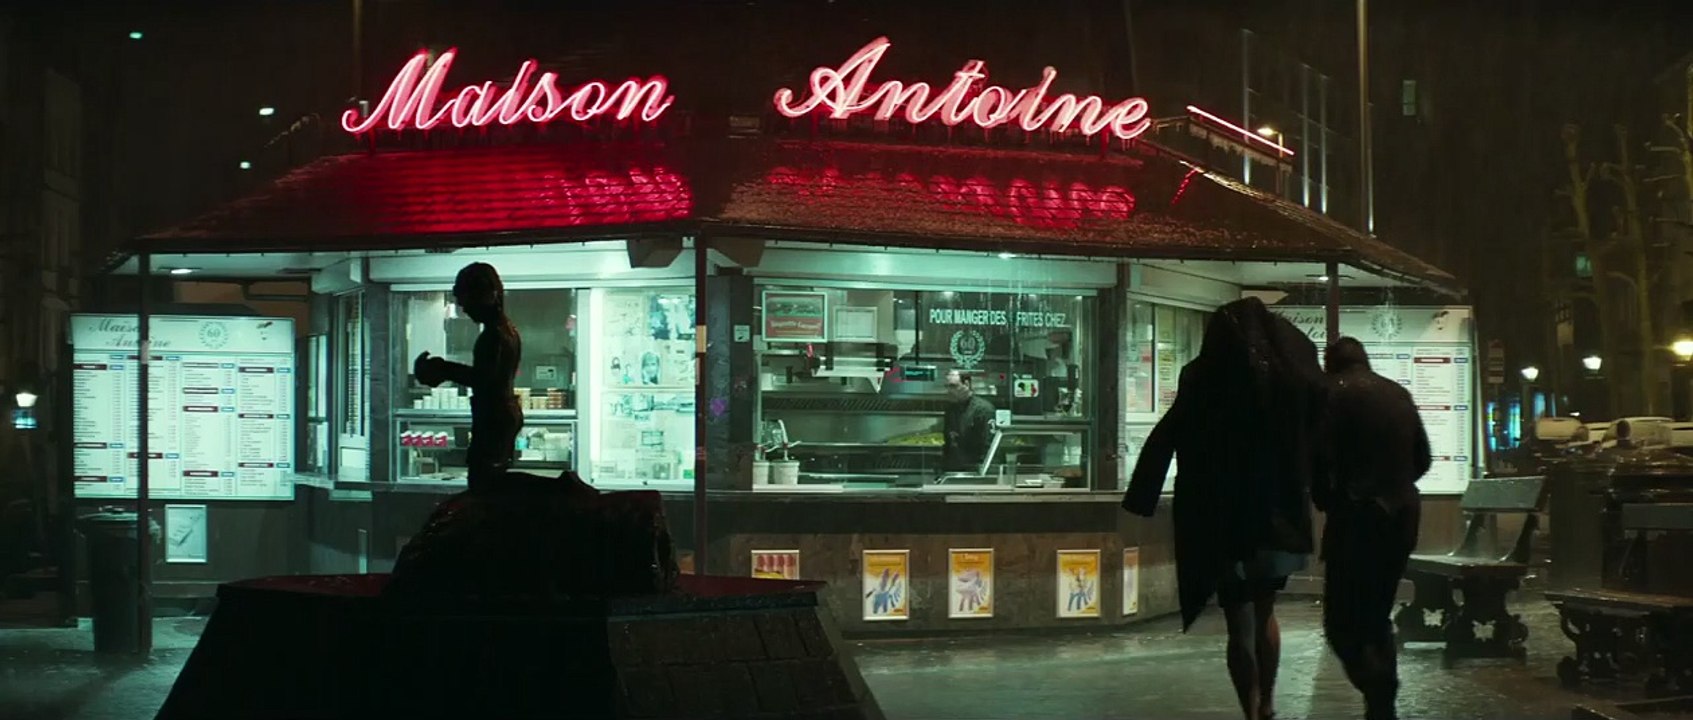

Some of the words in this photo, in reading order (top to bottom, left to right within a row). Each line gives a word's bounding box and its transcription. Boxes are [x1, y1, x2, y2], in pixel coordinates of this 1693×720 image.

[341, 47, 675, 134] Maison
[773, 36, 1152, 139] Antoine
[88, 318, 141, 334] Maiso
[929, 309, 953, 324] POUR
[954, 309, 989, 325] MANGER
[990, 310, 1007, 326] DES
[1016, 311, 1044, 327] FRITES
